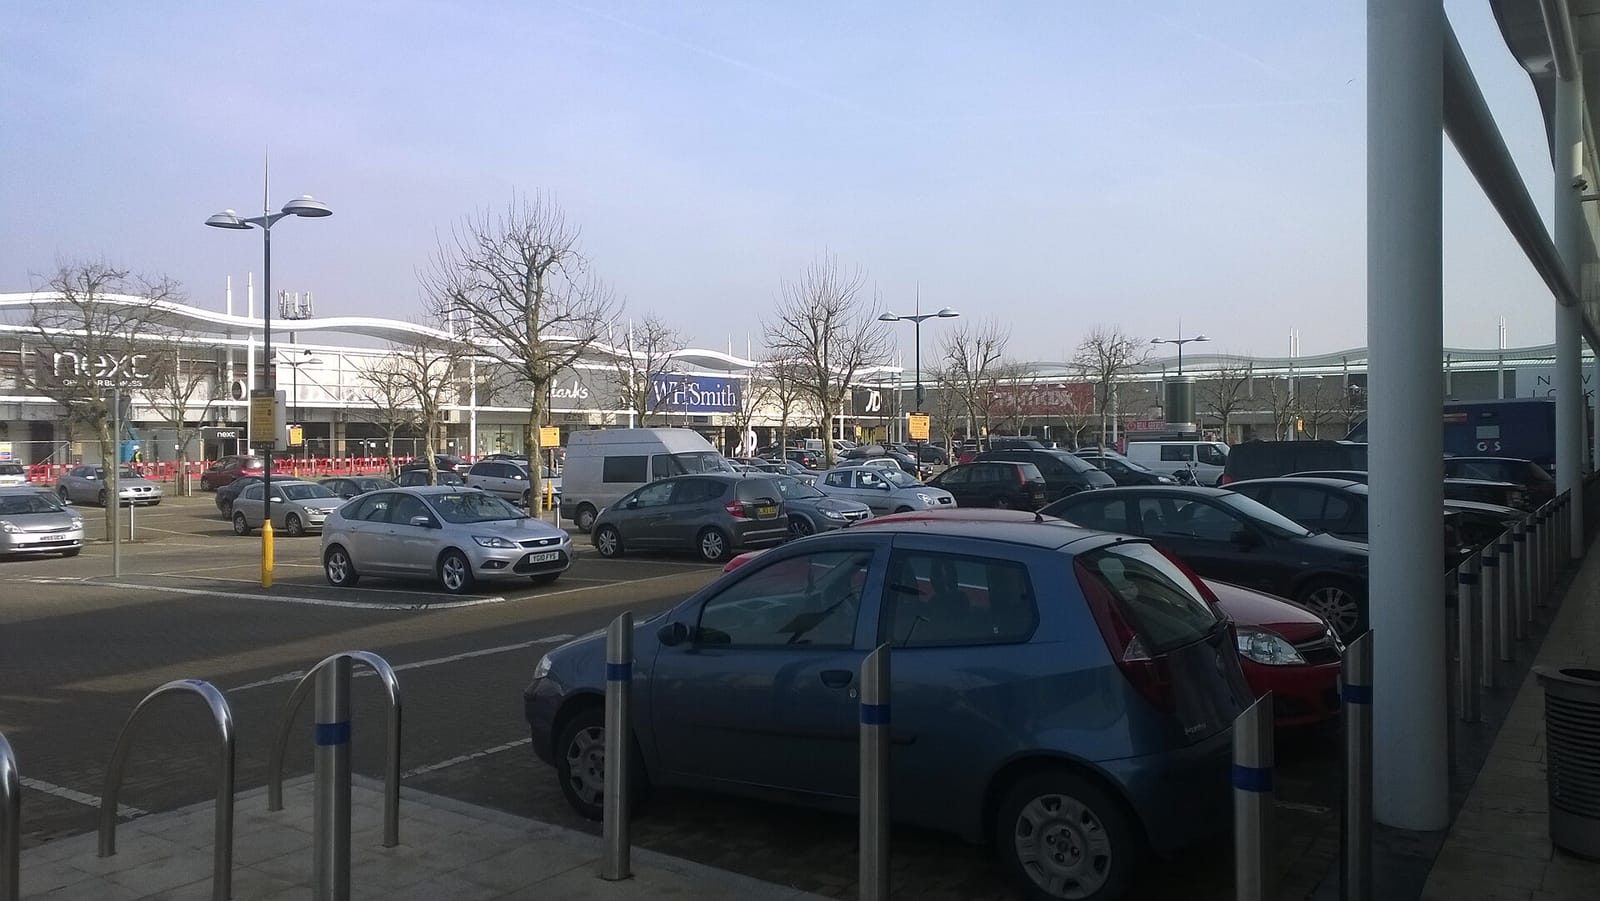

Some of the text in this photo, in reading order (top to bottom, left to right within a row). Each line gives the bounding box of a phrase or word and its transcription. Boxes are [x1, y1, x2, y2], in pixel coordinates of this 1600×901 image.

[53, 352, 150, 378] next
[531, 378, 589, 400] larks
[652, 379, 736, 406] WHSmith
[865, 387, 883, 413] JD
[1476, 441, 1502, 452] GS
